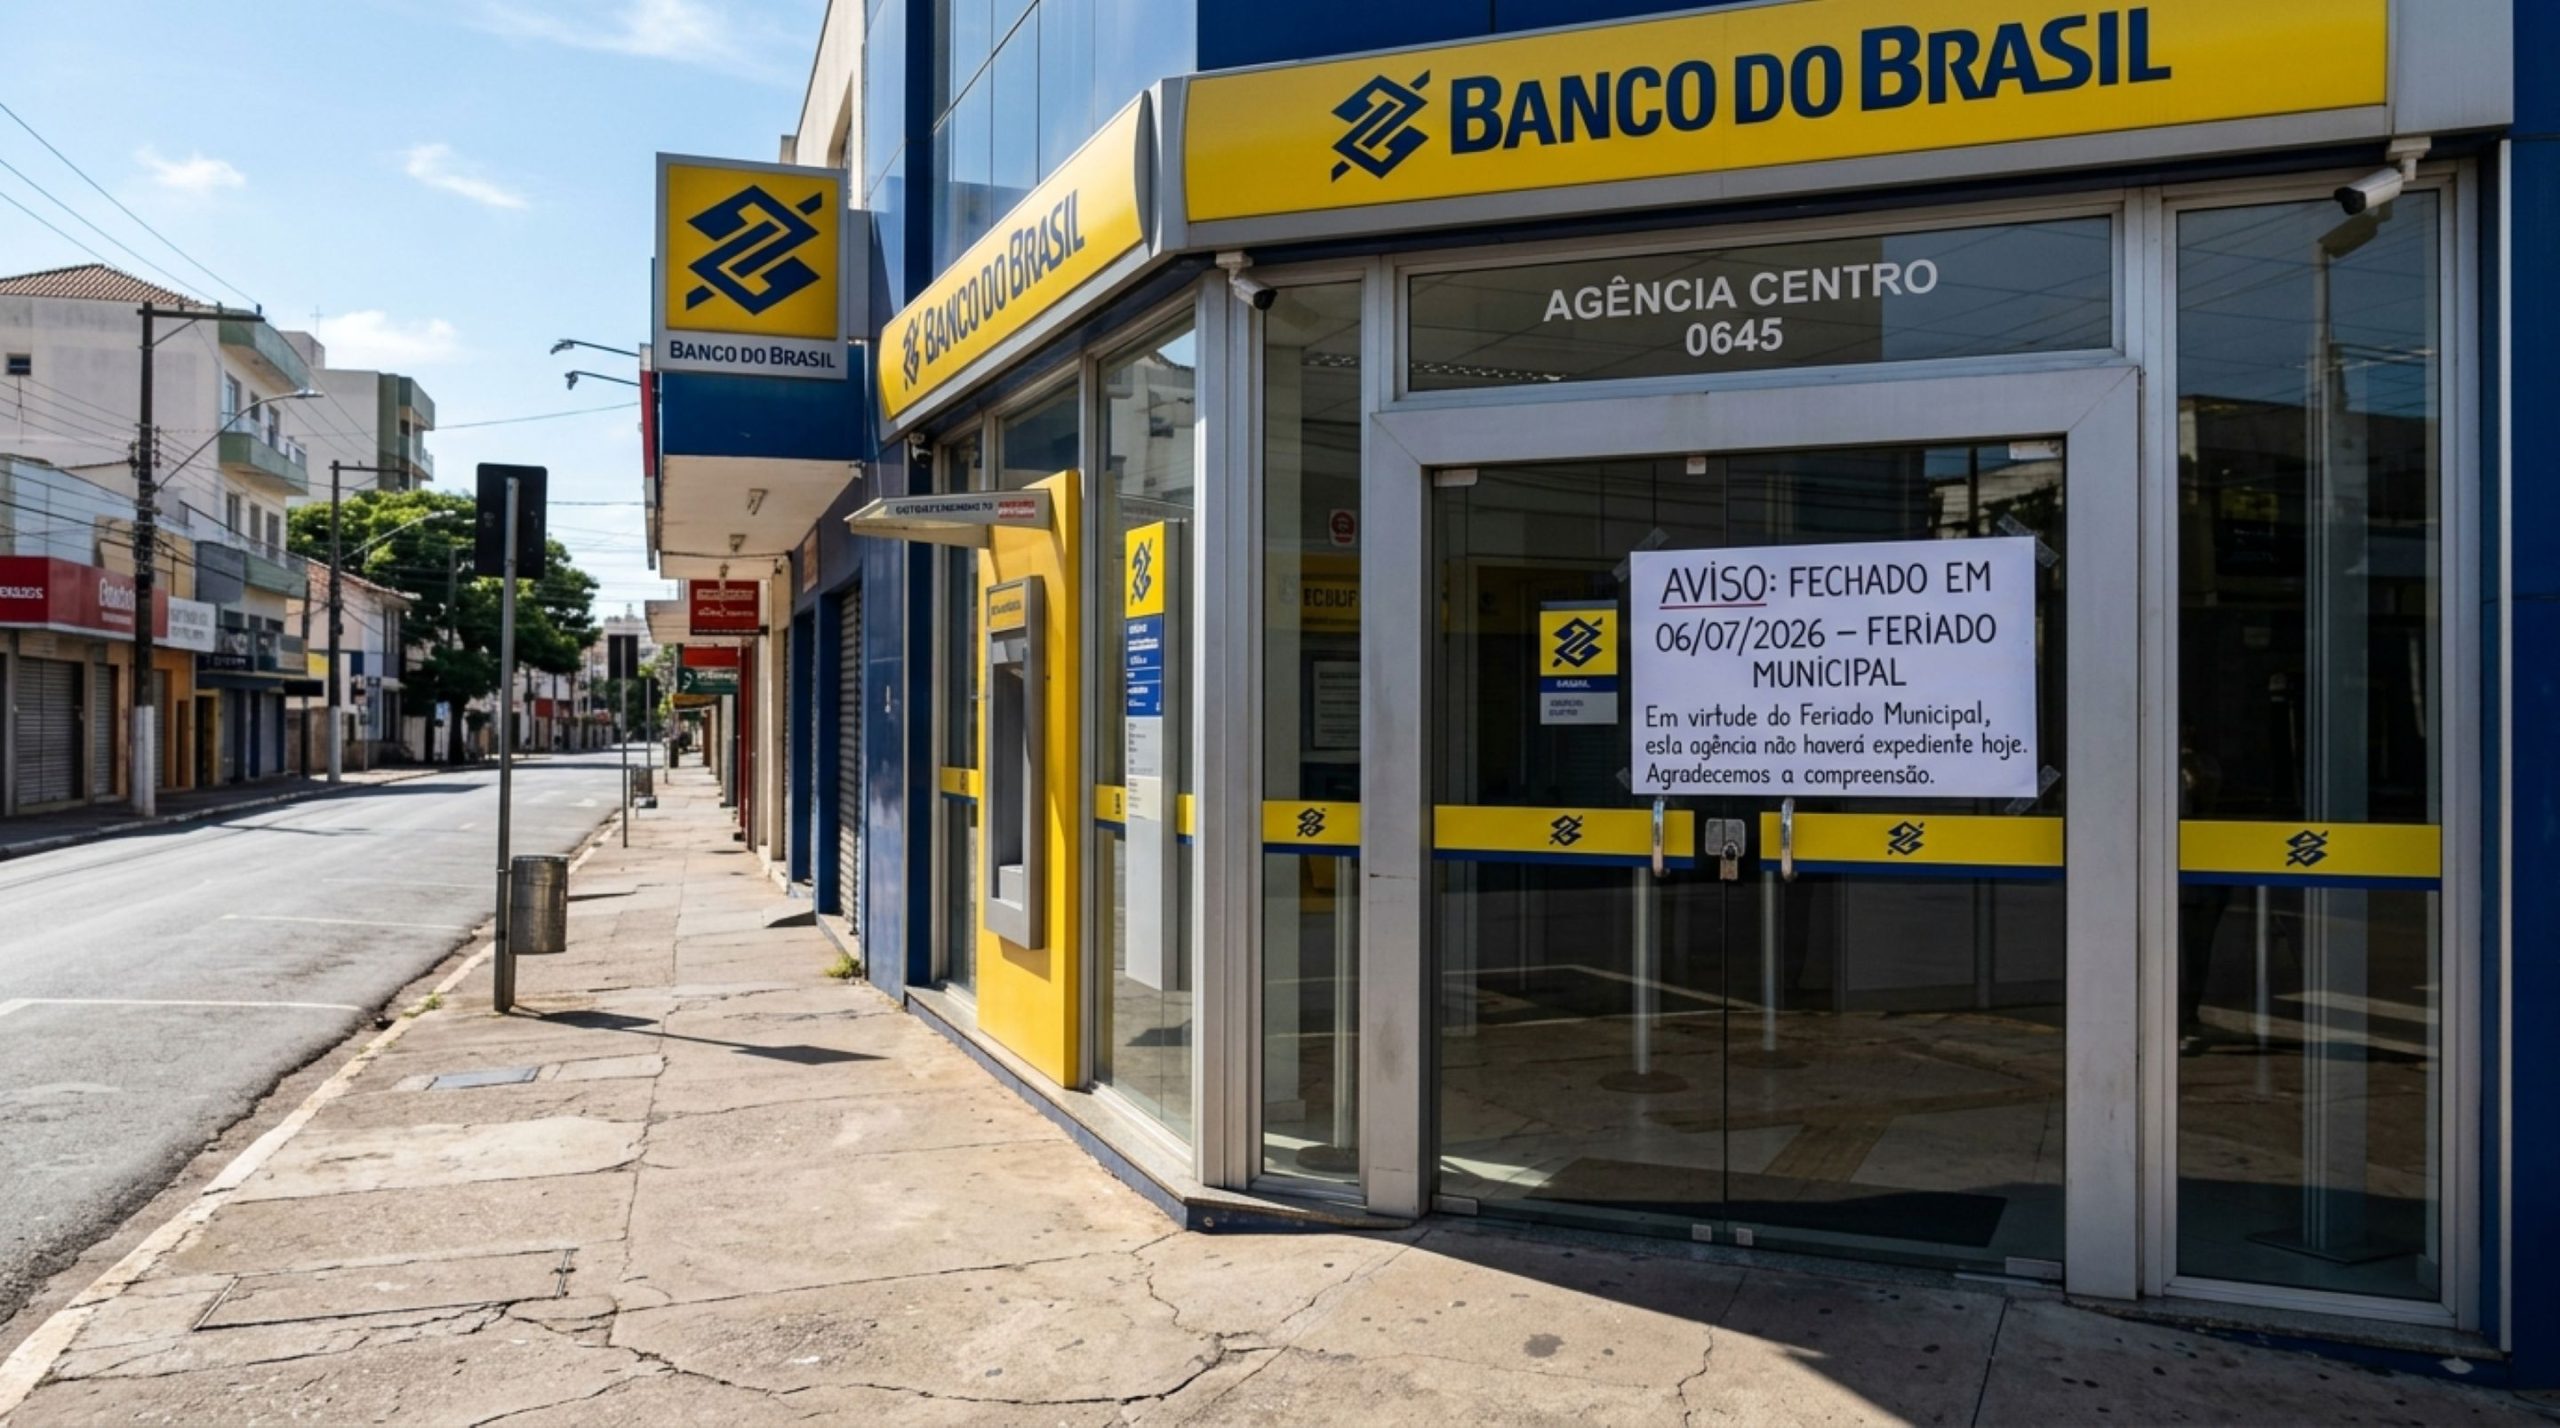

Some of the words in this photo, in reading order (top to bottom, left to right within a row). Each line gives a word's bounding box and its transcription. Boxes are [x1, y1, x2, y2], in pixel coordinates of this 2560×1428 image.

[1451, 60, 1717, 155] BANCO
[1735, 45, 1843, 125] DO
[1861, 7, 2172, 112] BRASIL
[925, 276, 979, 366] BANCO
[981, 253, 1007, 322] DO
[1010, 188, 1085, 300] BRASIL
[1543, 275, 1738, 322] AGÊNCIA
[1749, 259, 1938, 307] CENTRO
[670, 340, 737, 363] BANCO
[741, 347, 766, 364] DO
[770, 346, 836, 369] BRASIL
[1686, 317, 1783, 357] 0645
[1660, 561, 1777, 605] AVISO:
[1789, 561, 1928, 598] FECHADO
[1946, 561, 1991, 593] EM
[1656, 616, 1826, 657] 06/07/2026
[1867, 612, 1997, 646] FERIADO
[1753, 655, 1907, 689] MUNICIPAL
[1645, 704, 1679, 727] Em
[1688, 703, 1758, 728] virtude
[1767, 703, 1791, 727] do
[1800, 702, 1874, 726] Feriado
[1884, 699, 1991, 731] Municipal,
[1689, 734, 1758, 761] agência
[1764, 735, 1797, 755] não
[1803, 733, 1864, 754] haverá
[1872, 732, 1973, 760] expediente
[1982, 732, 2028, 761] hoje.
[1645, 762, 1771, 791] Agradecemos
[1781, 768, 1794, 784] a
[1803, 764, 1935, 790] compreensão.
